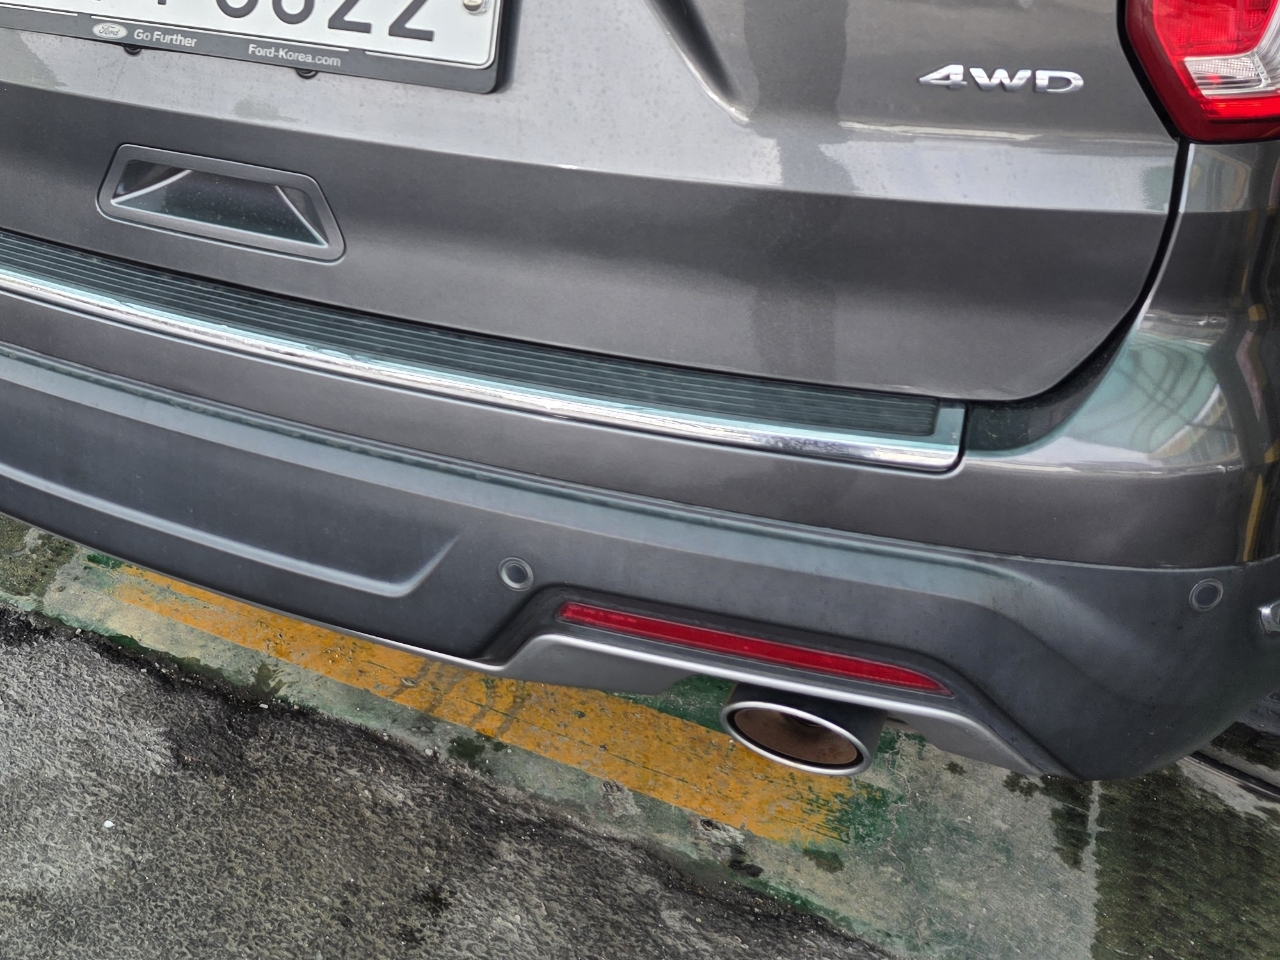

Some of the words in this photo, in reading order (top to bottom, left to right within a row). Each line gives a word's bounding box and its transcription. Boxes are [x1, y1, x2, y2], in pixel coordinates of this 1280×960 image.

[98, 24, 122, 37] Ford
[133, 28, 151, 41] Go
[152, 31, 197, 48] Further
[248, 43, 342, 68] Ford-Korea.com
[918, 64, 1084, 95] 4WD
